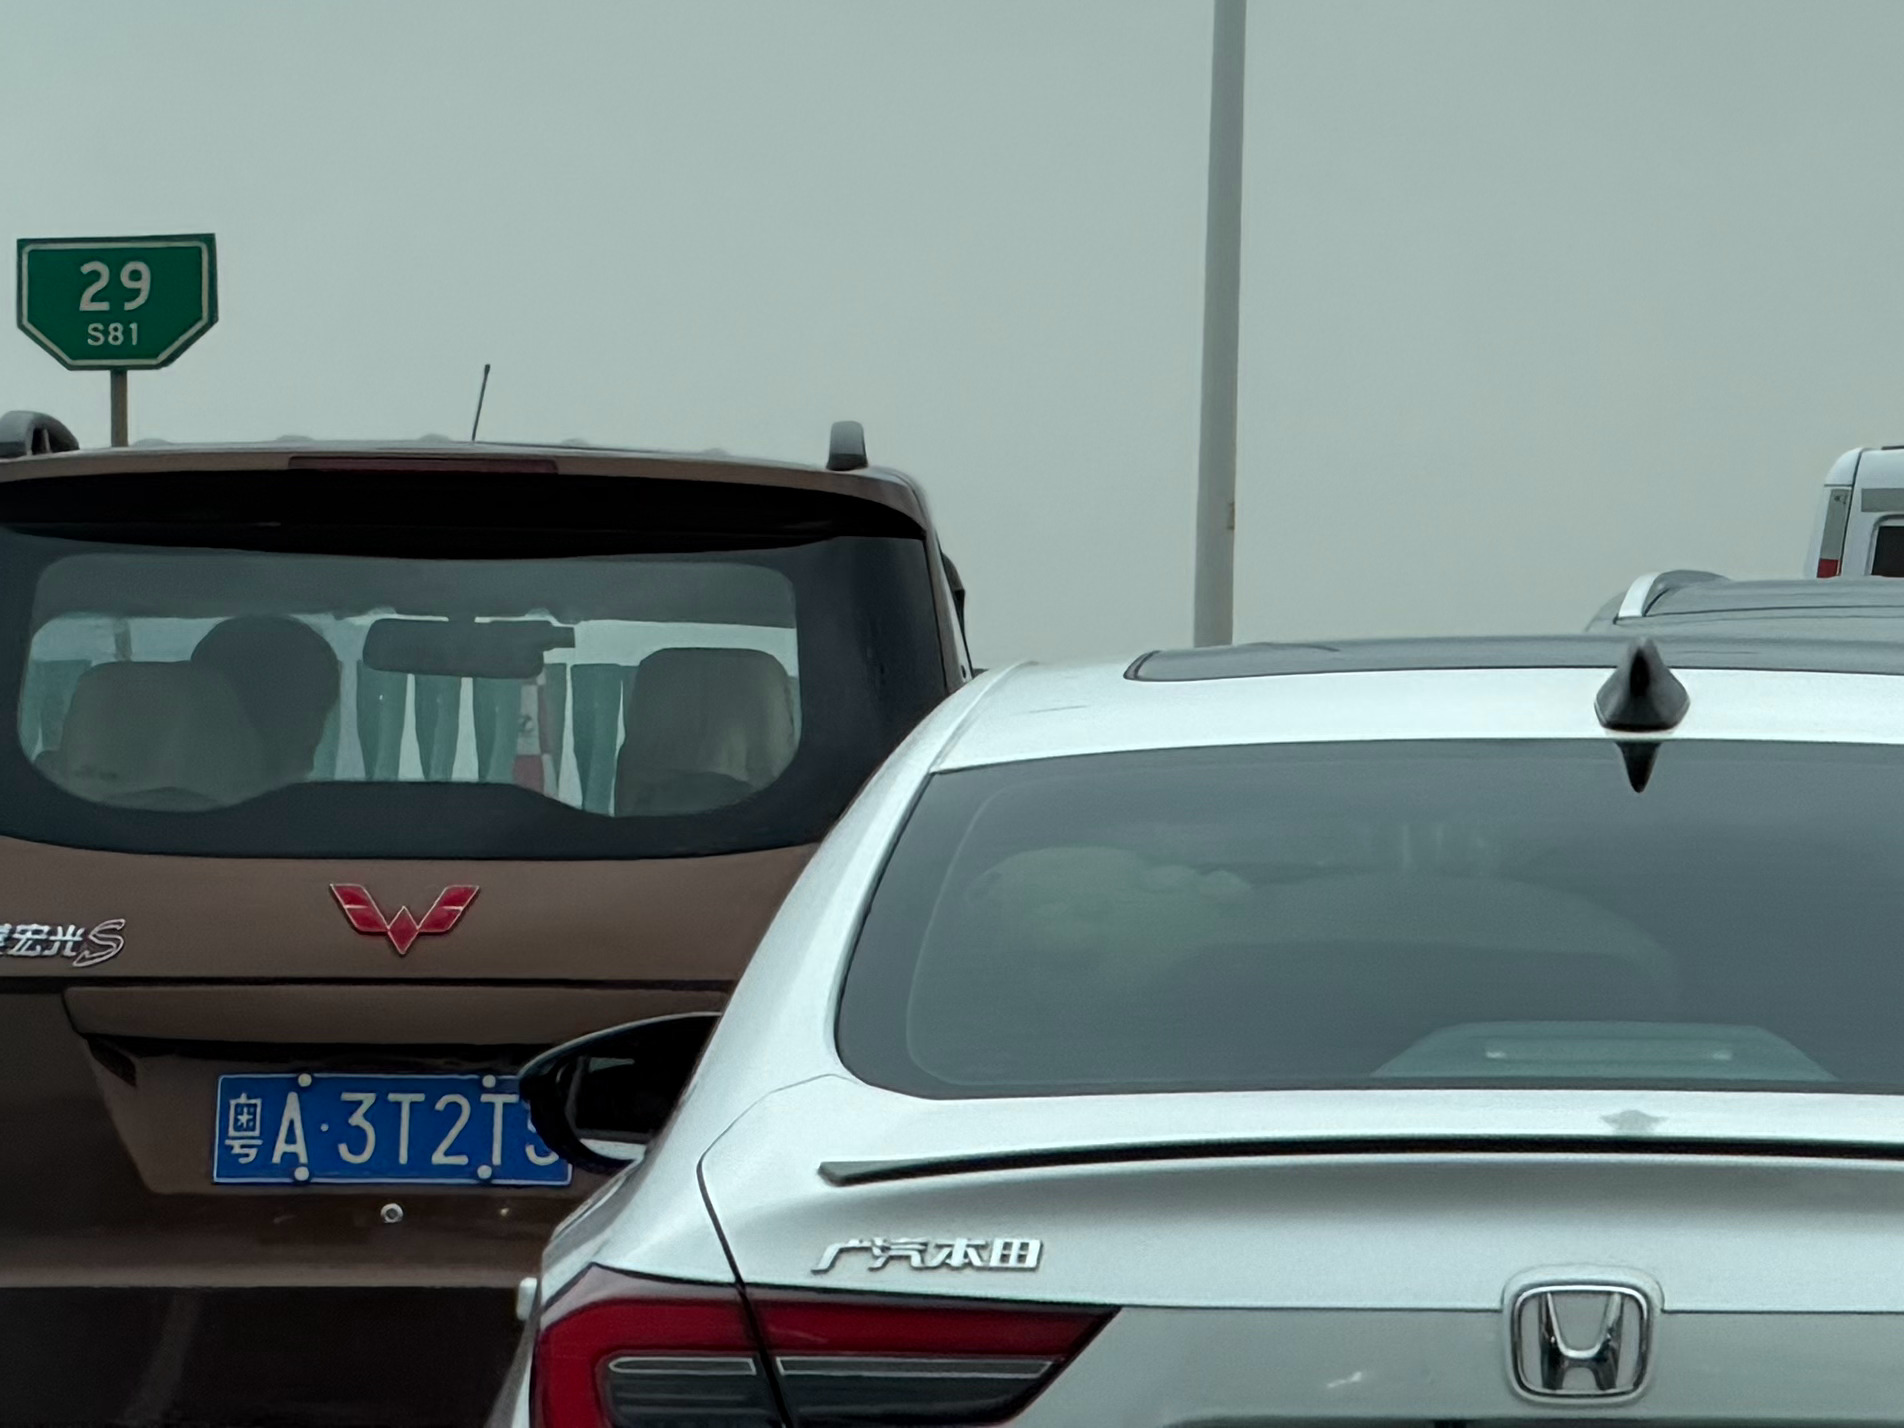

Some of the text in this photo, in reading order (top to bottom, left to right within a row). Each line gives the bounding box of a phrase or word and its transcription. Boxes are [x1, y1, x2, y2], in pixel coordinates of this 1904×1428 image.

[79, 260, 152, 312] 29
[87, 322, 138, 346] S81
[811, 1237, 1043, 1274] 广汽本田
